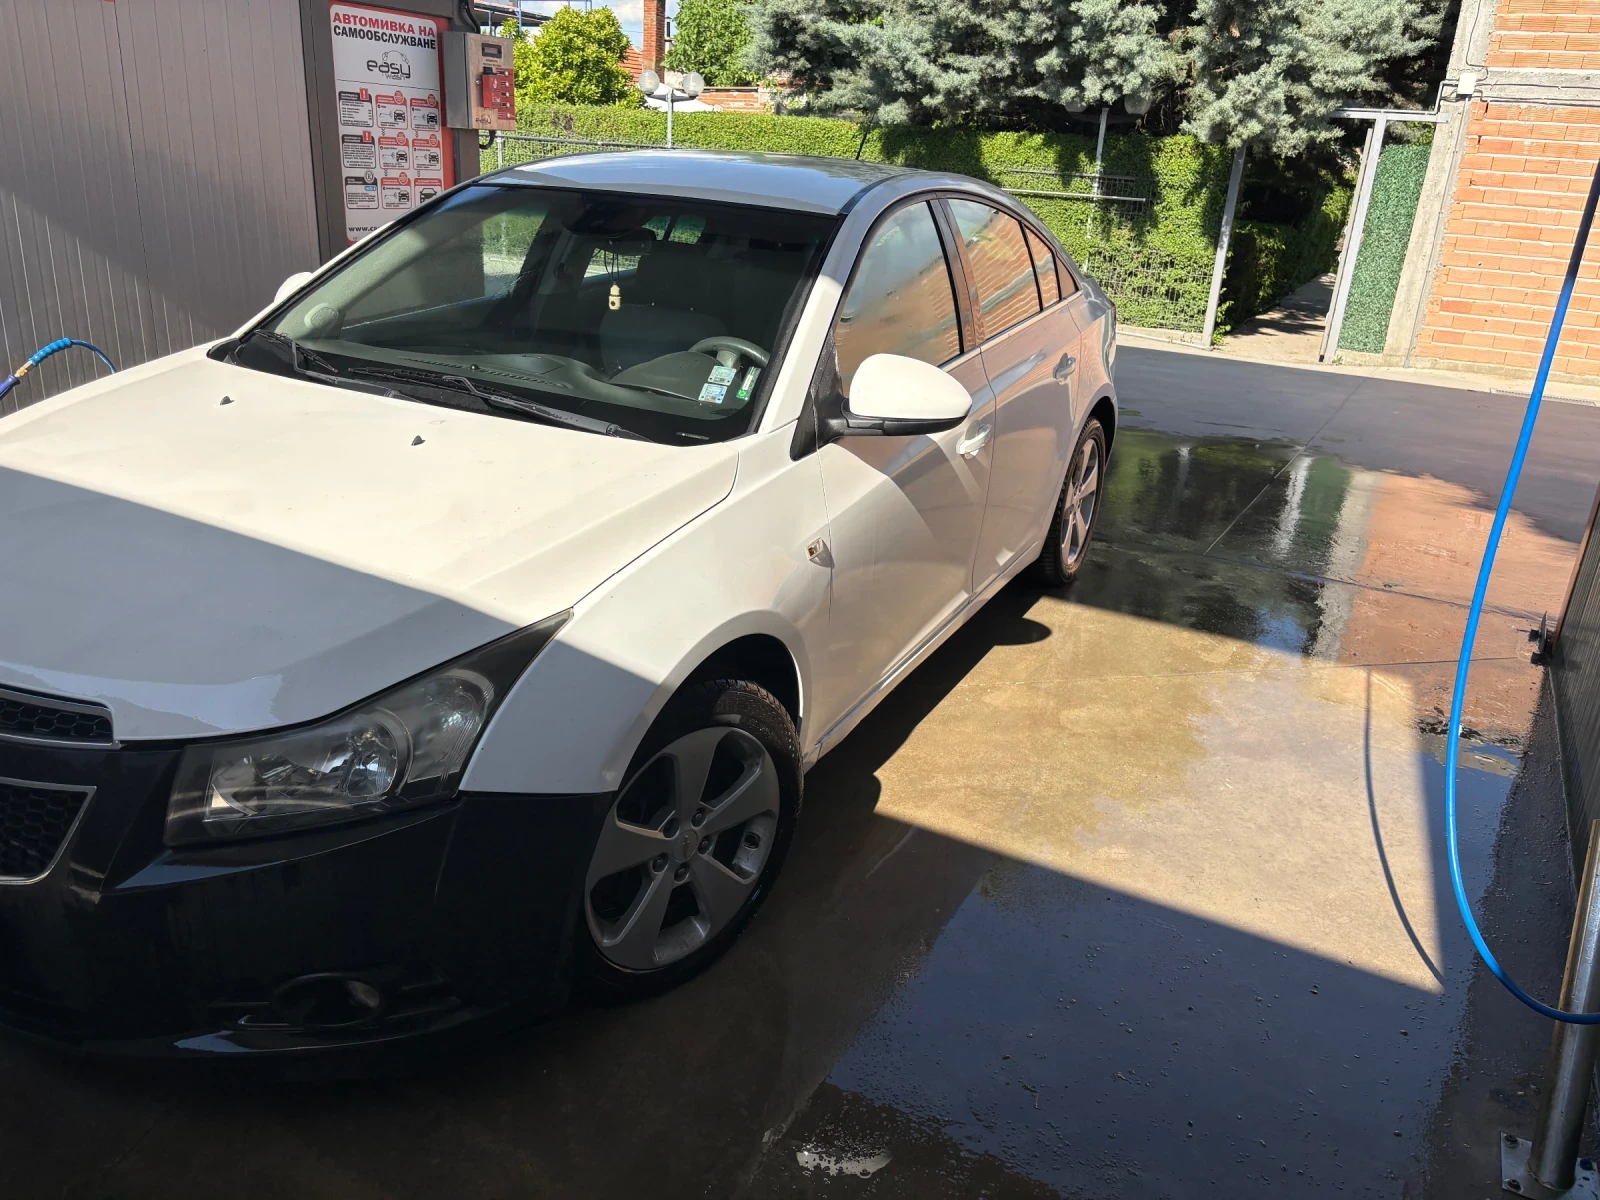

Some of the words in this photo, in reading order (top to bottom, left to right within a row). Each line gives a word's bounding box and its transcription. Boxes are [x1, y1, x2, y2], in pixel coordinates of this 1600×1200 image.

[333, 12, 415, 34] АВТОМИВКА
[418, 25, 435, 37] НА
[333, 25, 436, 50] САМООБСЛУЖВАНЕ
[366, 59, 411, 79] easy
